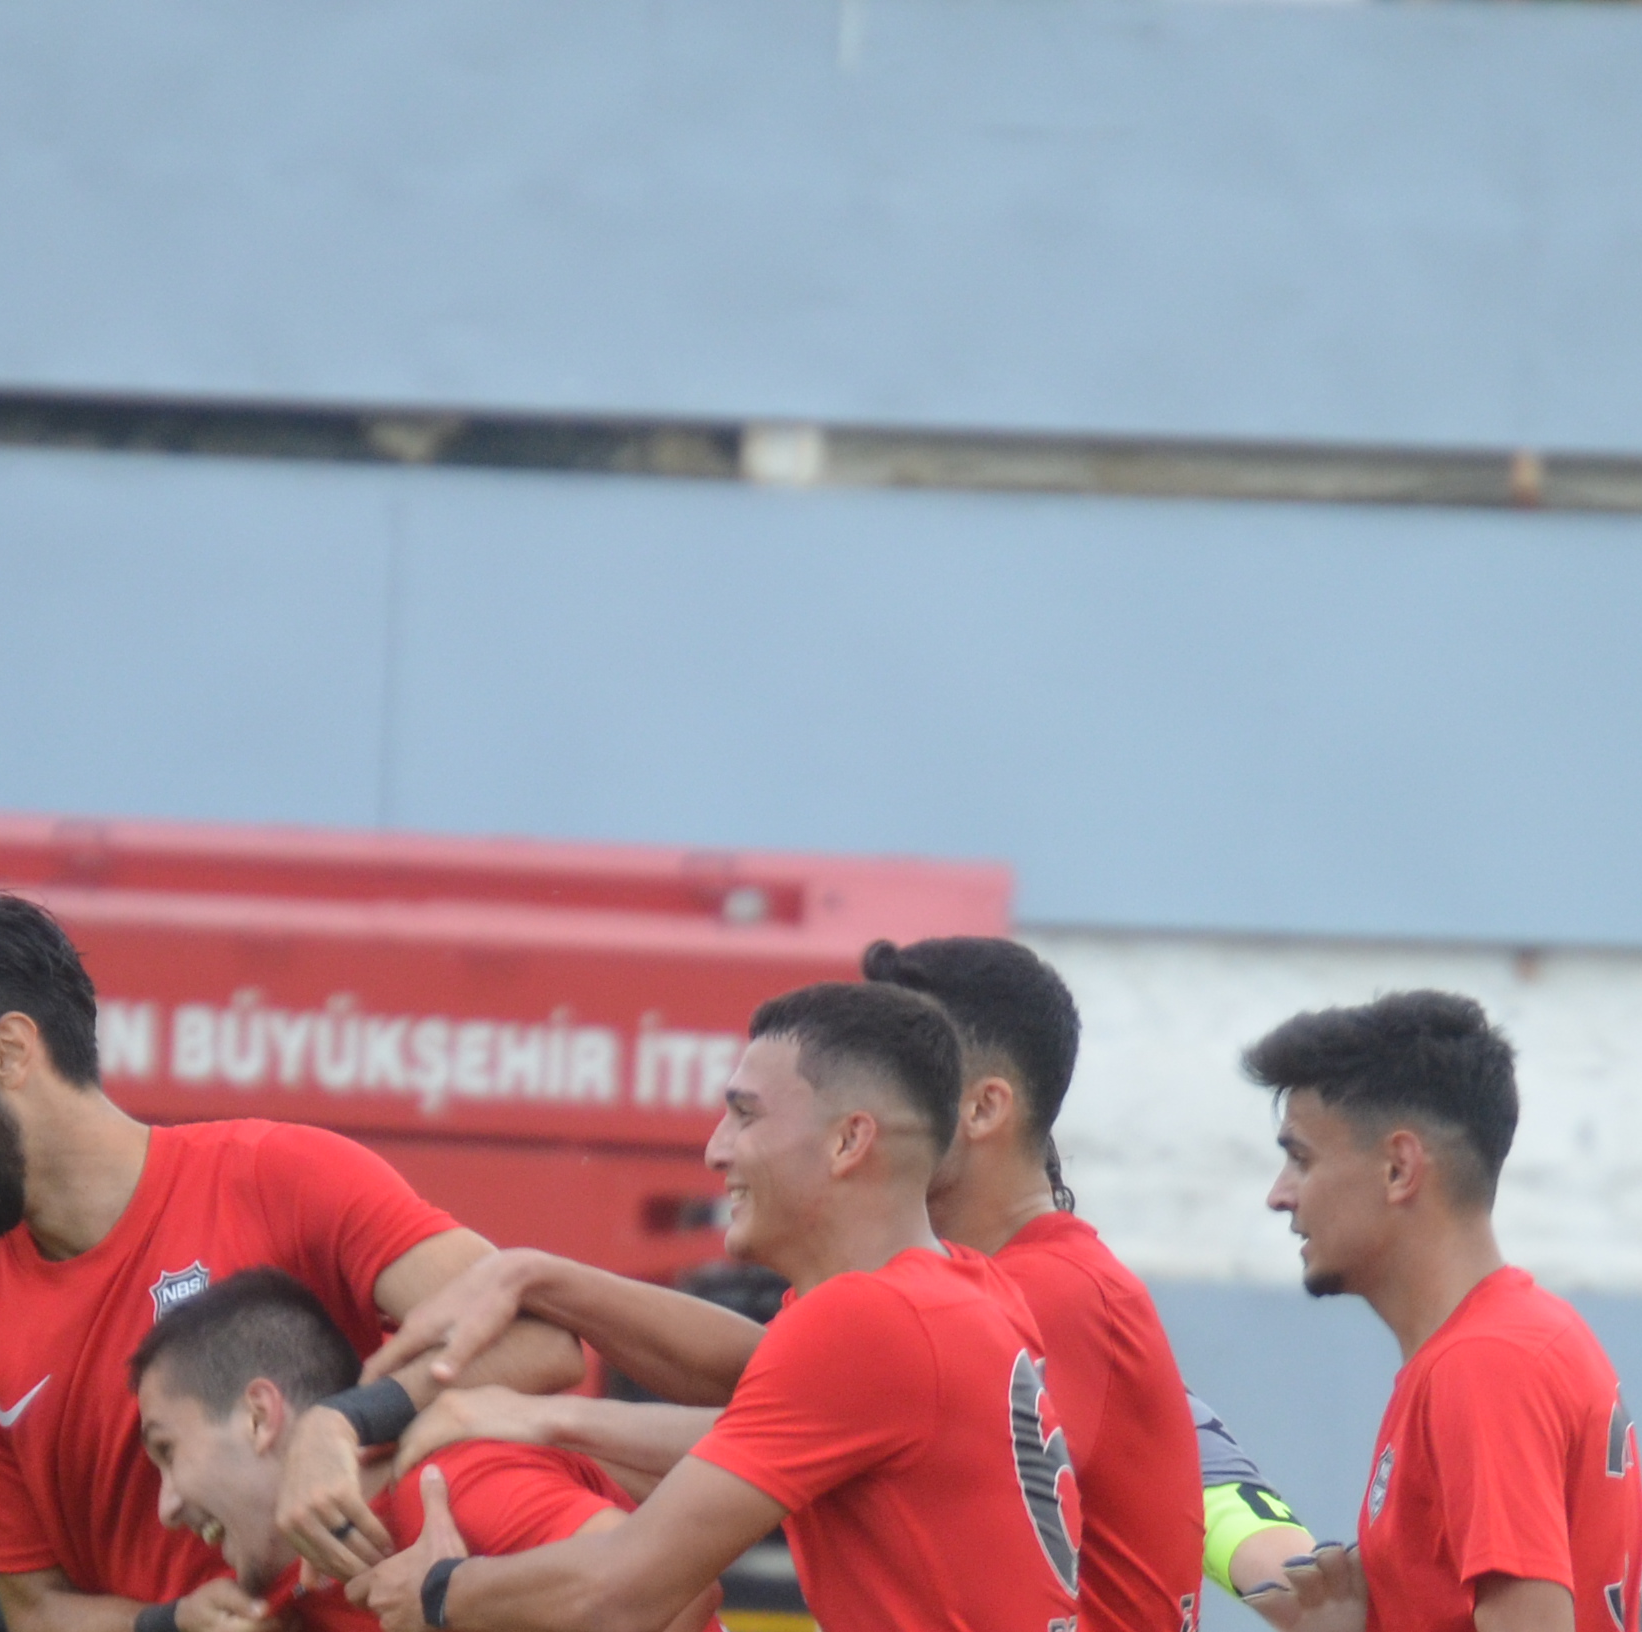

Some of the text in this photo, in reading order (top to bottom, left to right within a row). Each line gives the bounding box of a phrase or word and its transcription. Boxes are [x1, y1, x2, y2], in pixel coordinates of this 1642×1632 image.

[170, 988, 618, 1114] BÜYÜKŞEHİR
[635, 1010, 743, 1111] İTF
[162, 1276, 202, 1304] NBS
